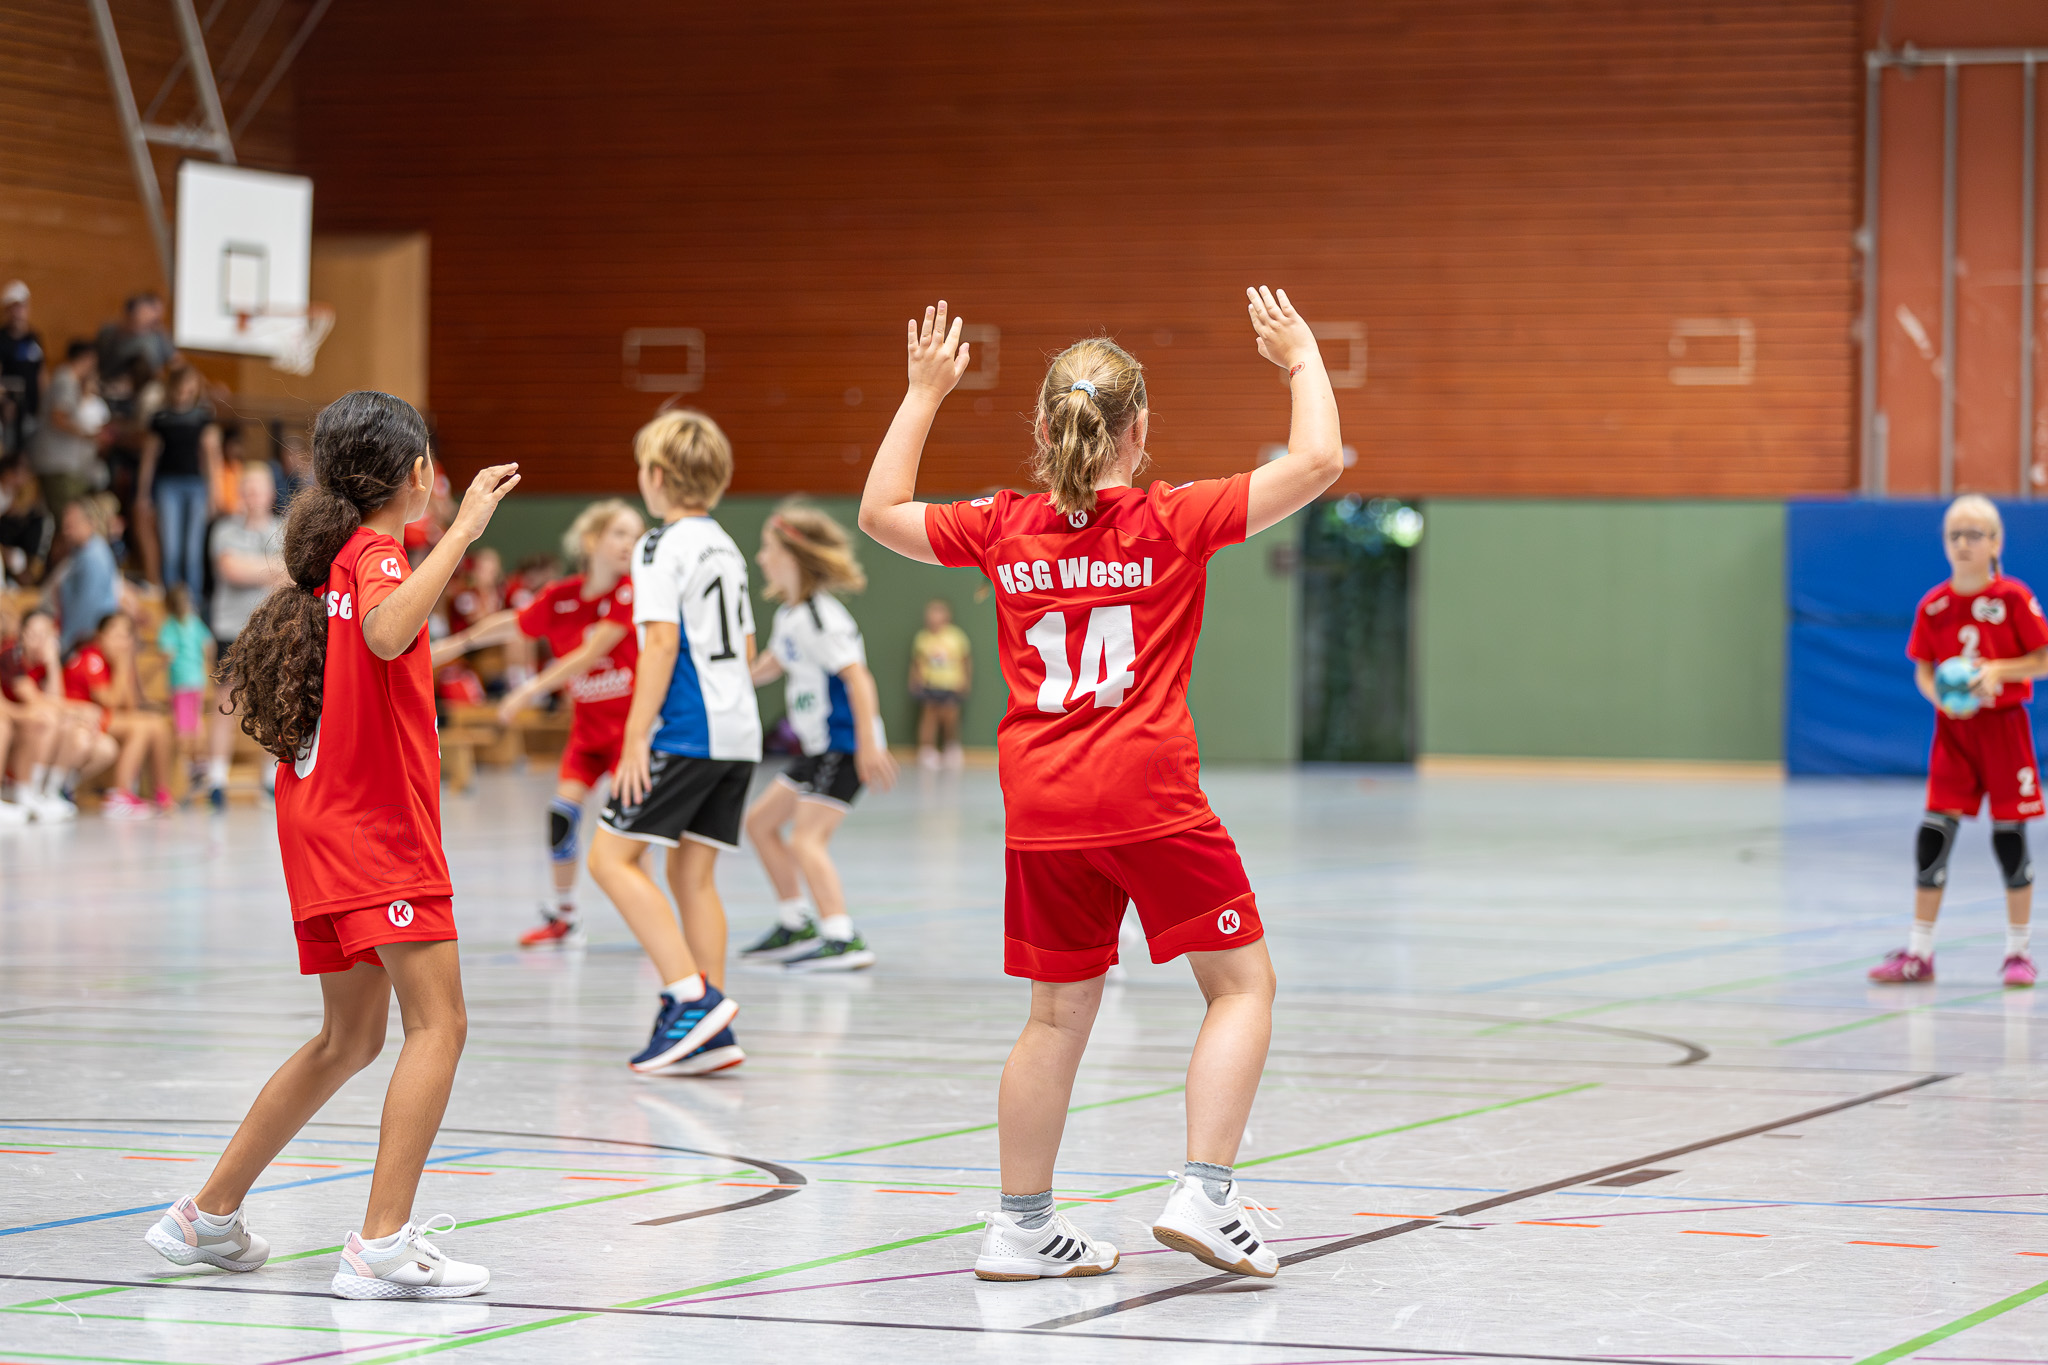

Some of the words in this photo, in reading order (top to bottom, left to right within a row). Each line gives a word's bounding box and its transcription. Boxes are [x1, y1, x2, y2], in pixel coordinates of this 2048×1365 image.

[997, 560, 1054, 594] HSG
[1058, 556, 1153, 590] Wesel
[321, 590, 353, 620] se
[1025, 604, 1136, 714] 14
[2016, 766, 2036, 798] 2
